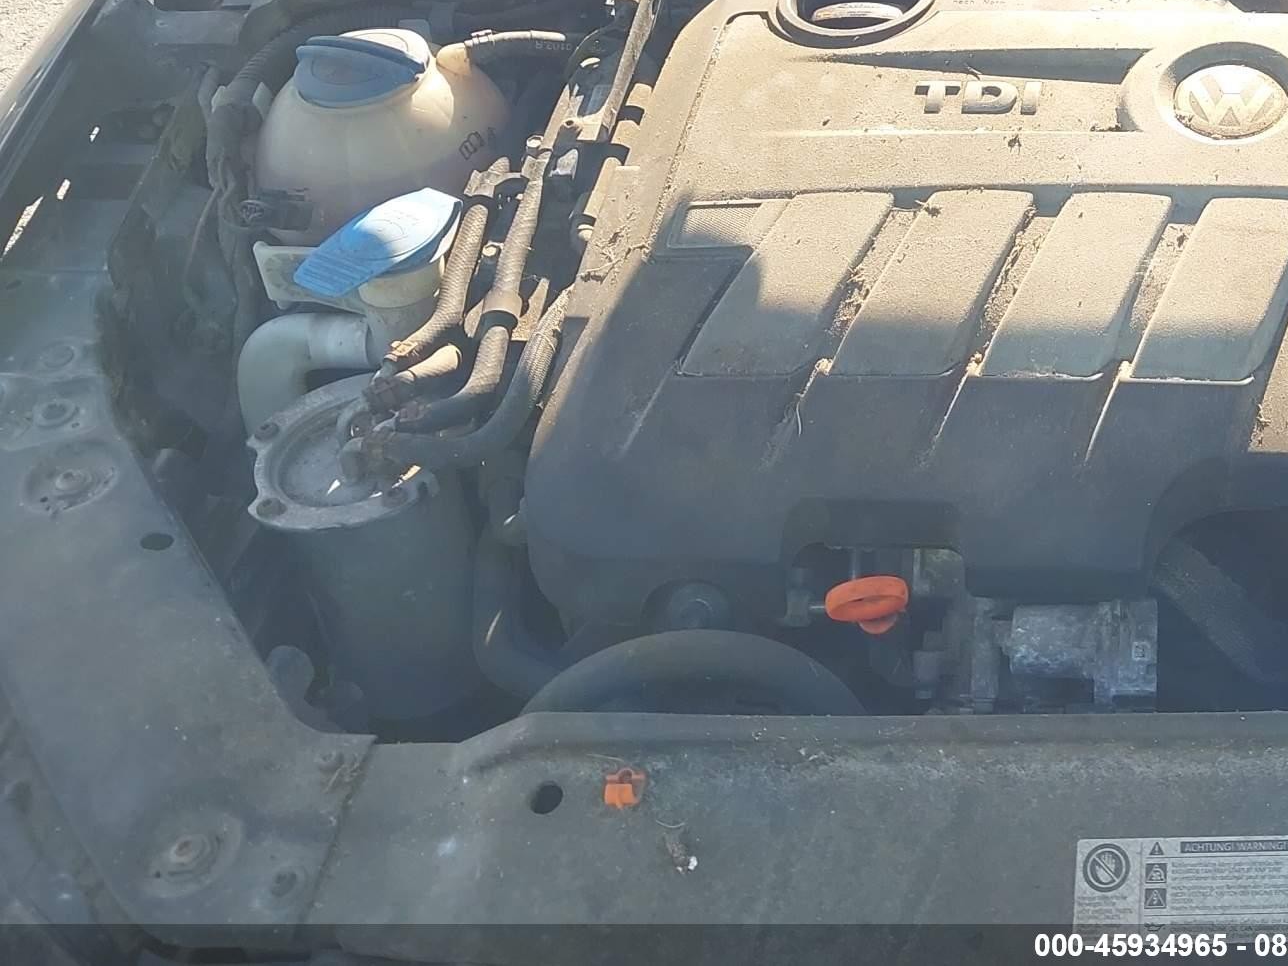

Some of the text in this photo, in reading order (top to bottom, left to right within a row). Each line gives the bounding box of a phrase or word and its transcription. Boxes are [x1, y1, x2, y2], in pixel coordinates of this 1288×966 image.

[914, 79, 1043, 116] TDI
[1184, 841, 1235, 852] ACHTUNG!
[1238, 840, 1286, 851] WARNING!
